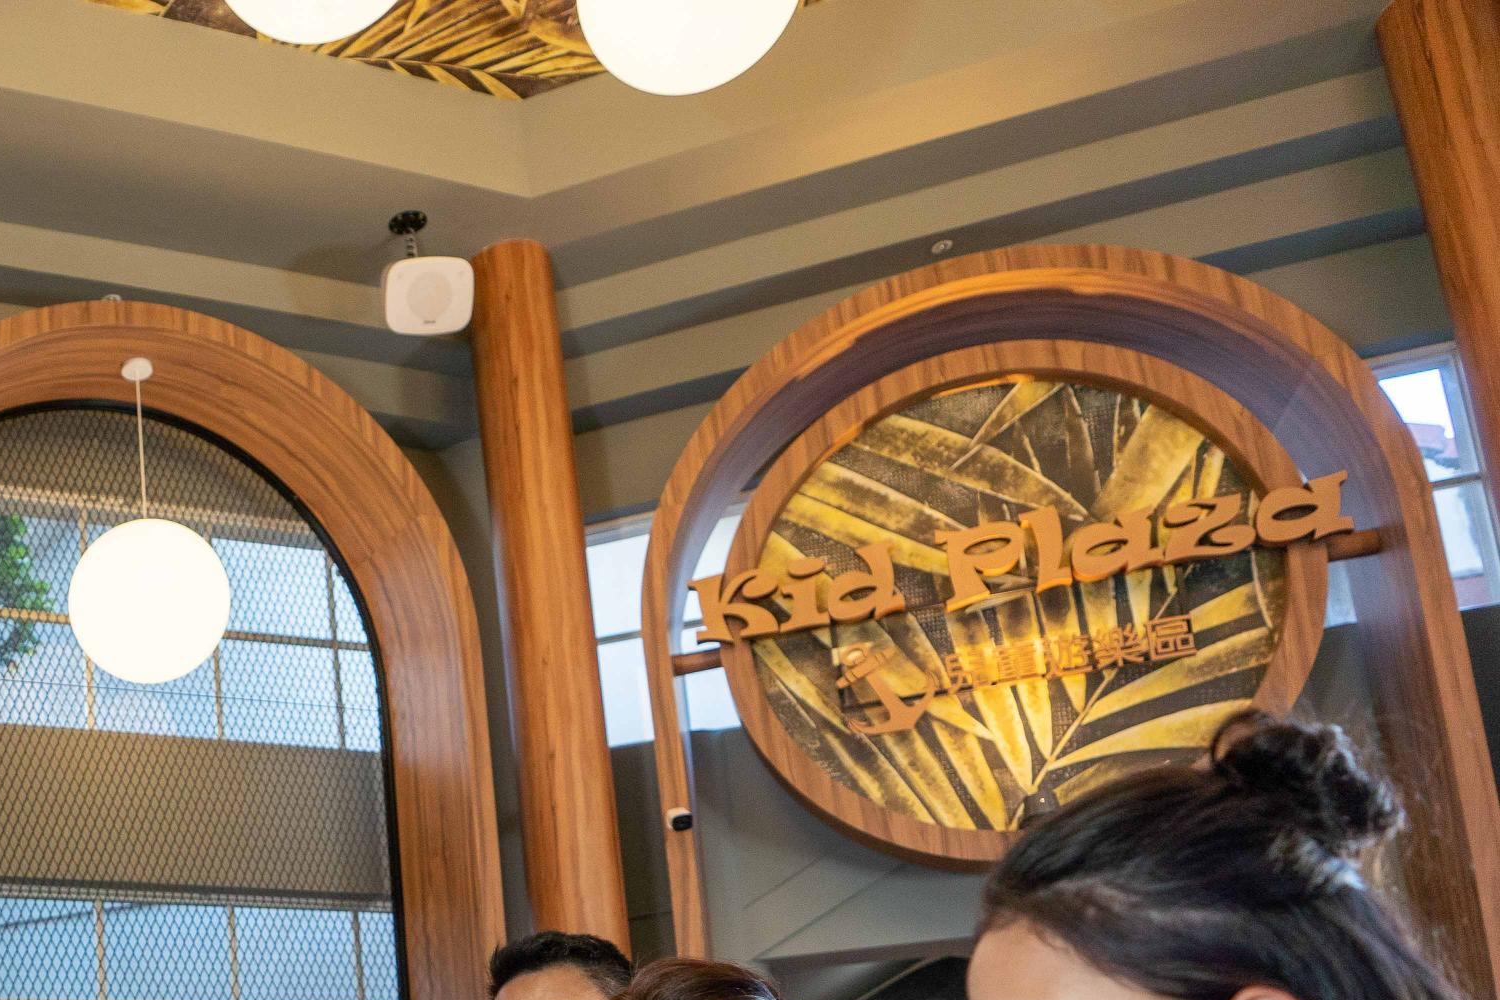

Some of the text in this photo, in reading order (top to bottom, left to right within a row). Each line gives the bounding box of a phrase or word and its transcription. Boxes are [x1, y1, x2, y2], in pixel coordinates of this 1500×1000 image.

[687, 470, 1355, 643] Kid Plaza
[946, 613, 1197, 696] 兒童遊樂區
